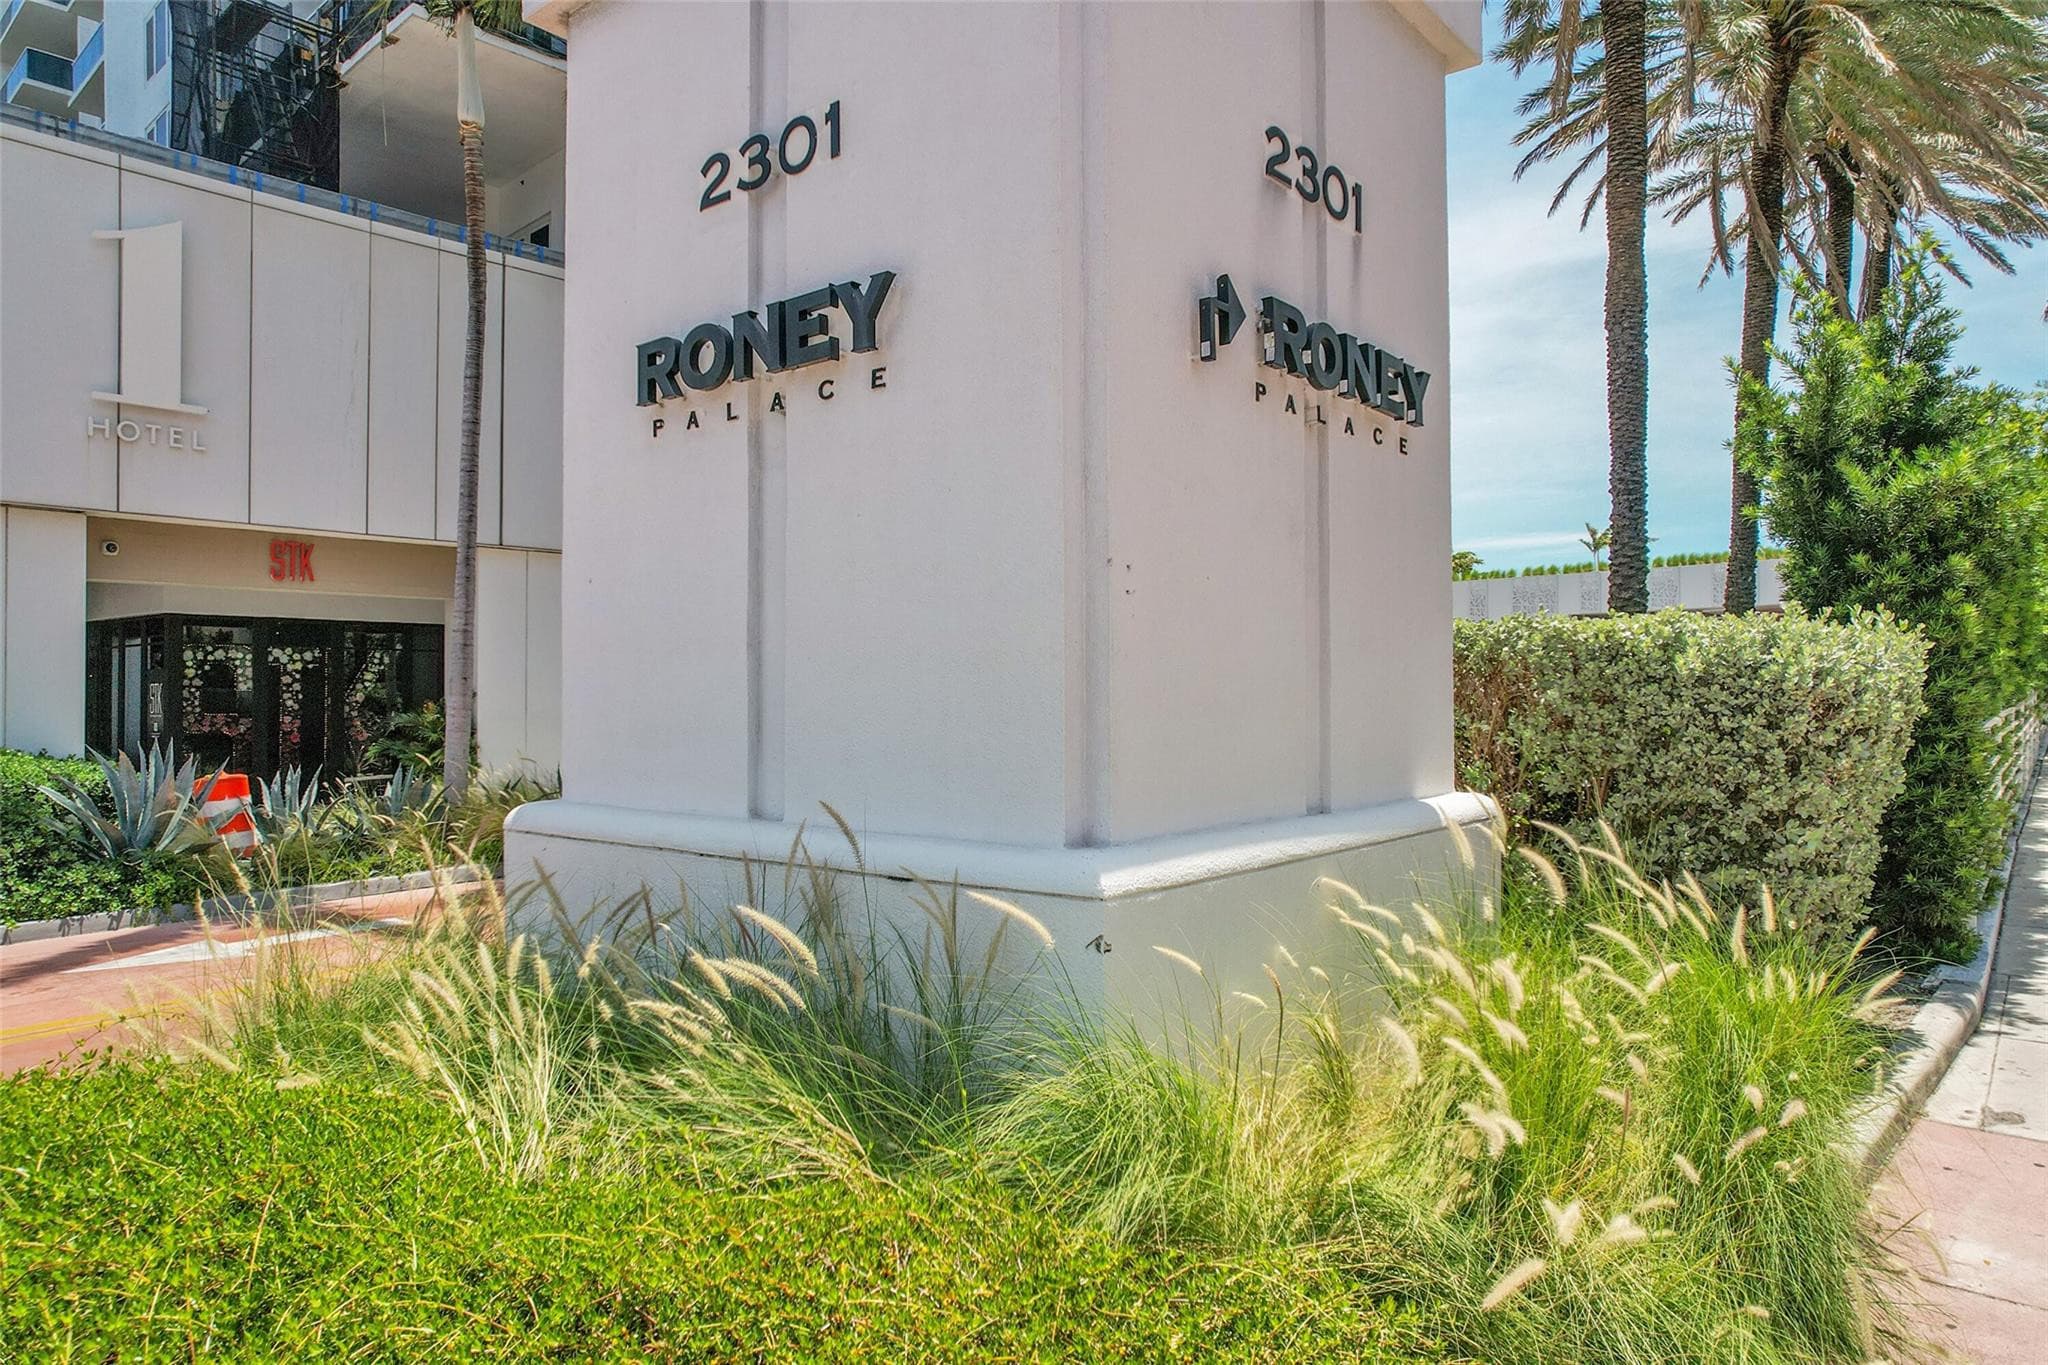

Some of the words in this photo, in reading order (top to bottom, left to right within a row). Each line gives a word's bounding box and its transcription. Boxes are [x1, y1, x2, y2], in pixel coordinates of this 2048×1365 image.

[700, 100, 841, 212] 2301
[1265, 125, 1362, 233] 2301
[635, 270, 897, 407] RONEY
[1260, 296, 1431, 427] RONEY
[87, 416, 207, 450] HOTEL
[652, 367, 887, 437] PALACE
[1255, 382, 1408, 455] PALACE
[270, 540, 316, 582] STK
[149, 683, 163, 714] STK
